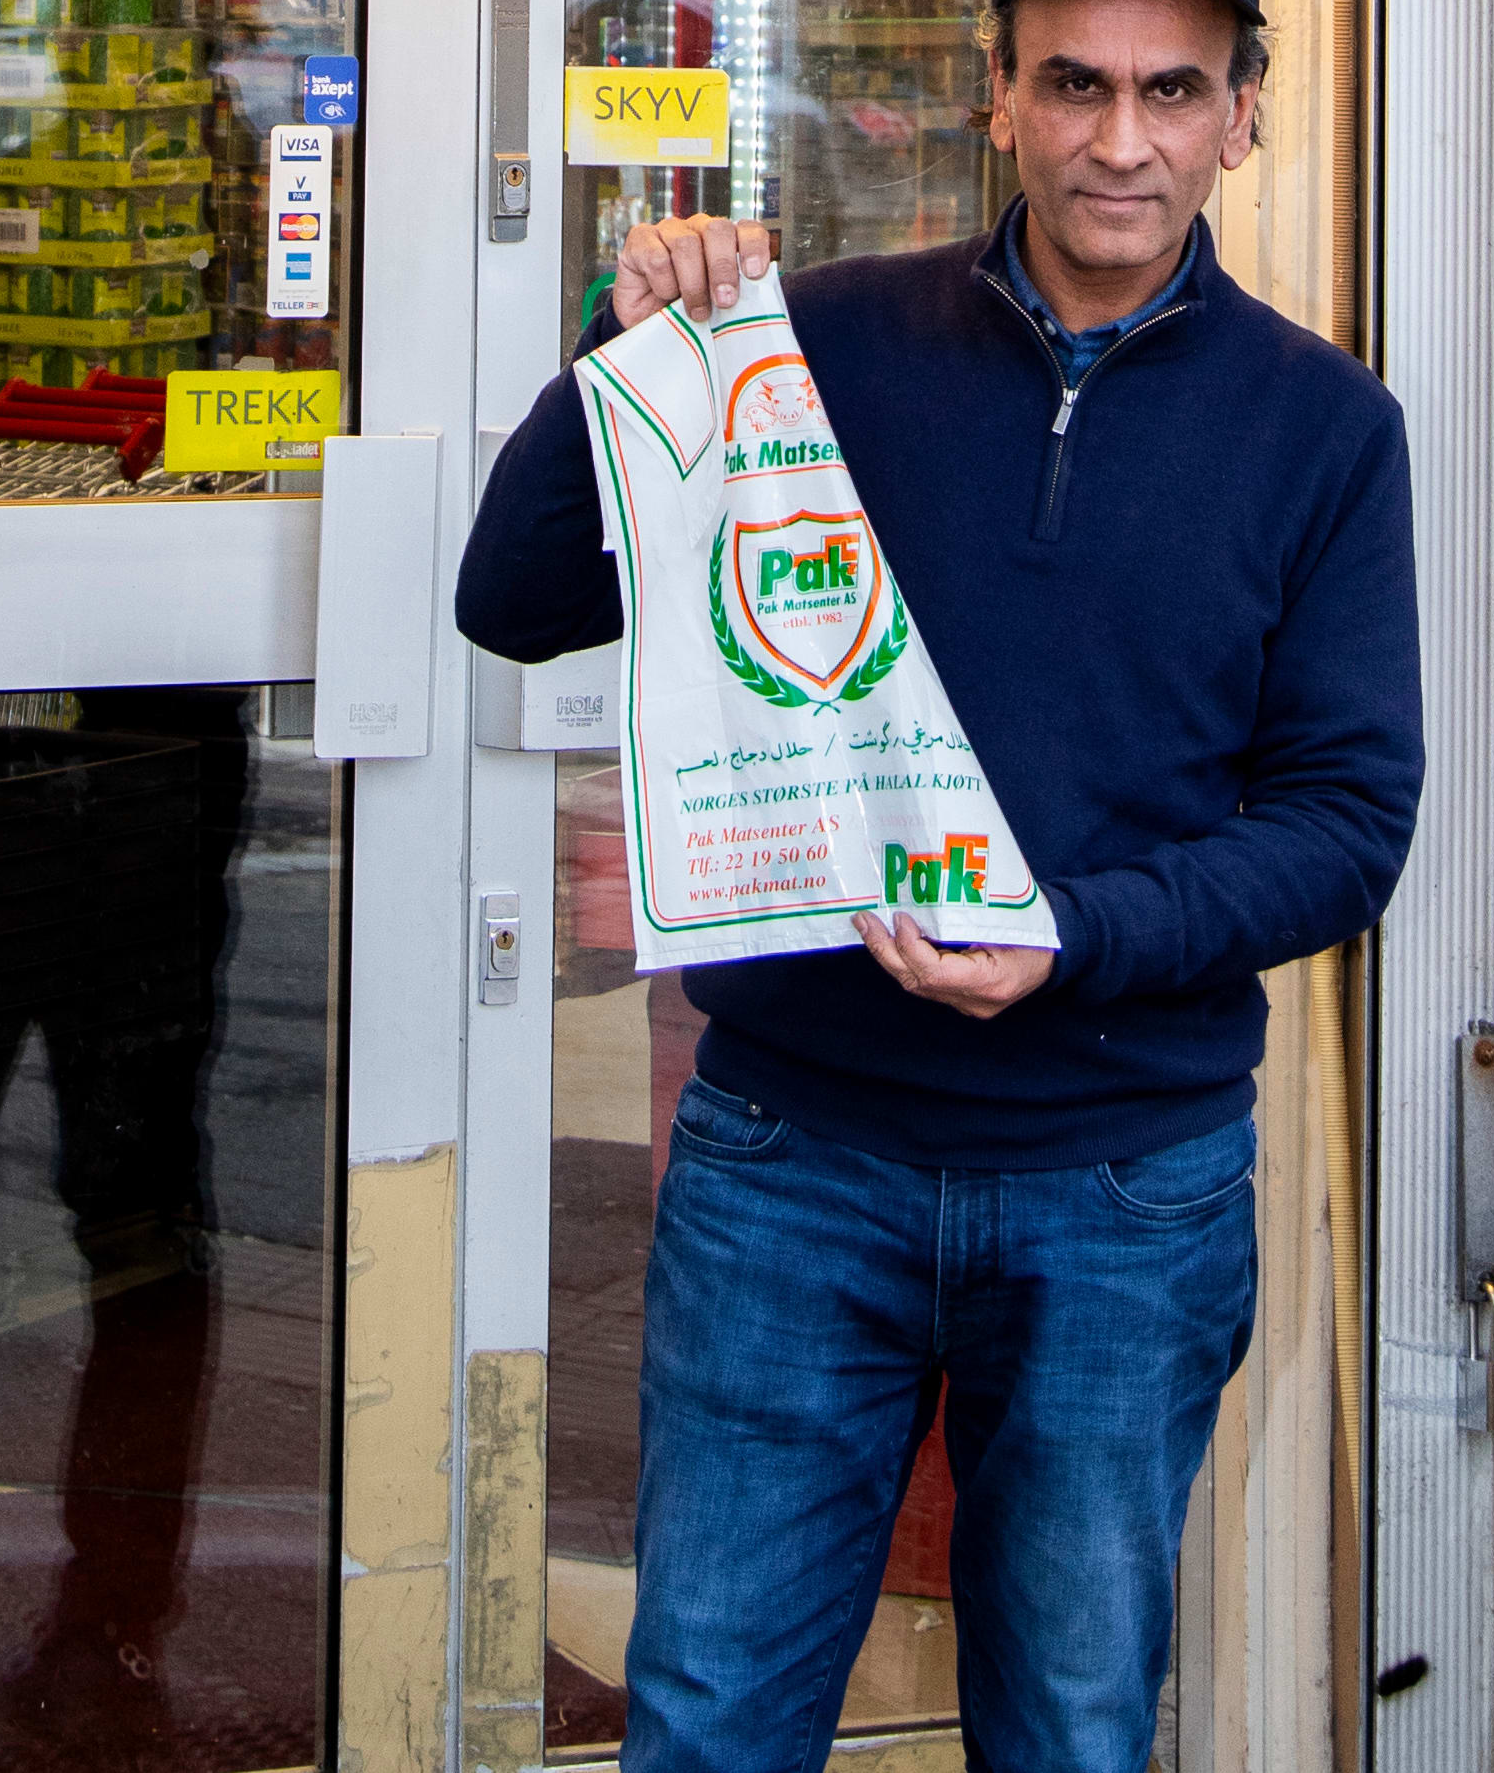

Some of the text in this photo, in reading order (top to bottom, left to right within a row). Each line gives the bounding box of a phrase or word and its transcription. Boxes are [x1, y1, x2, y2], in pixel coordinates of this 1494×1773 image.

[311, 80, 354, 100] axept
[594, 85, 703, 123] SKYV
[286, 137, 320, 151] VISA
[186, 389, 321, 426] TREKK
[724, 444, 748, 475] ak
[759, 540, 858, 597] Pak
[757, 592, 857, 615] Pak Matsenter AS
[816, 611, 843, 626] 1982
[557, 694, 604, 715] HOLE
[680, 772, 983, 815] NORGES STØRSTE PÅ HALAL KJØTT
[686, 830, 716, 850] Pak
[719, 821, 807, 846] Matsenter
[688, 843, 828, 881] Tlf.: 22 19 50 60
[884, 839, 988, 905] Pak
[689, 874, 827, 903] www.pakmat.no
